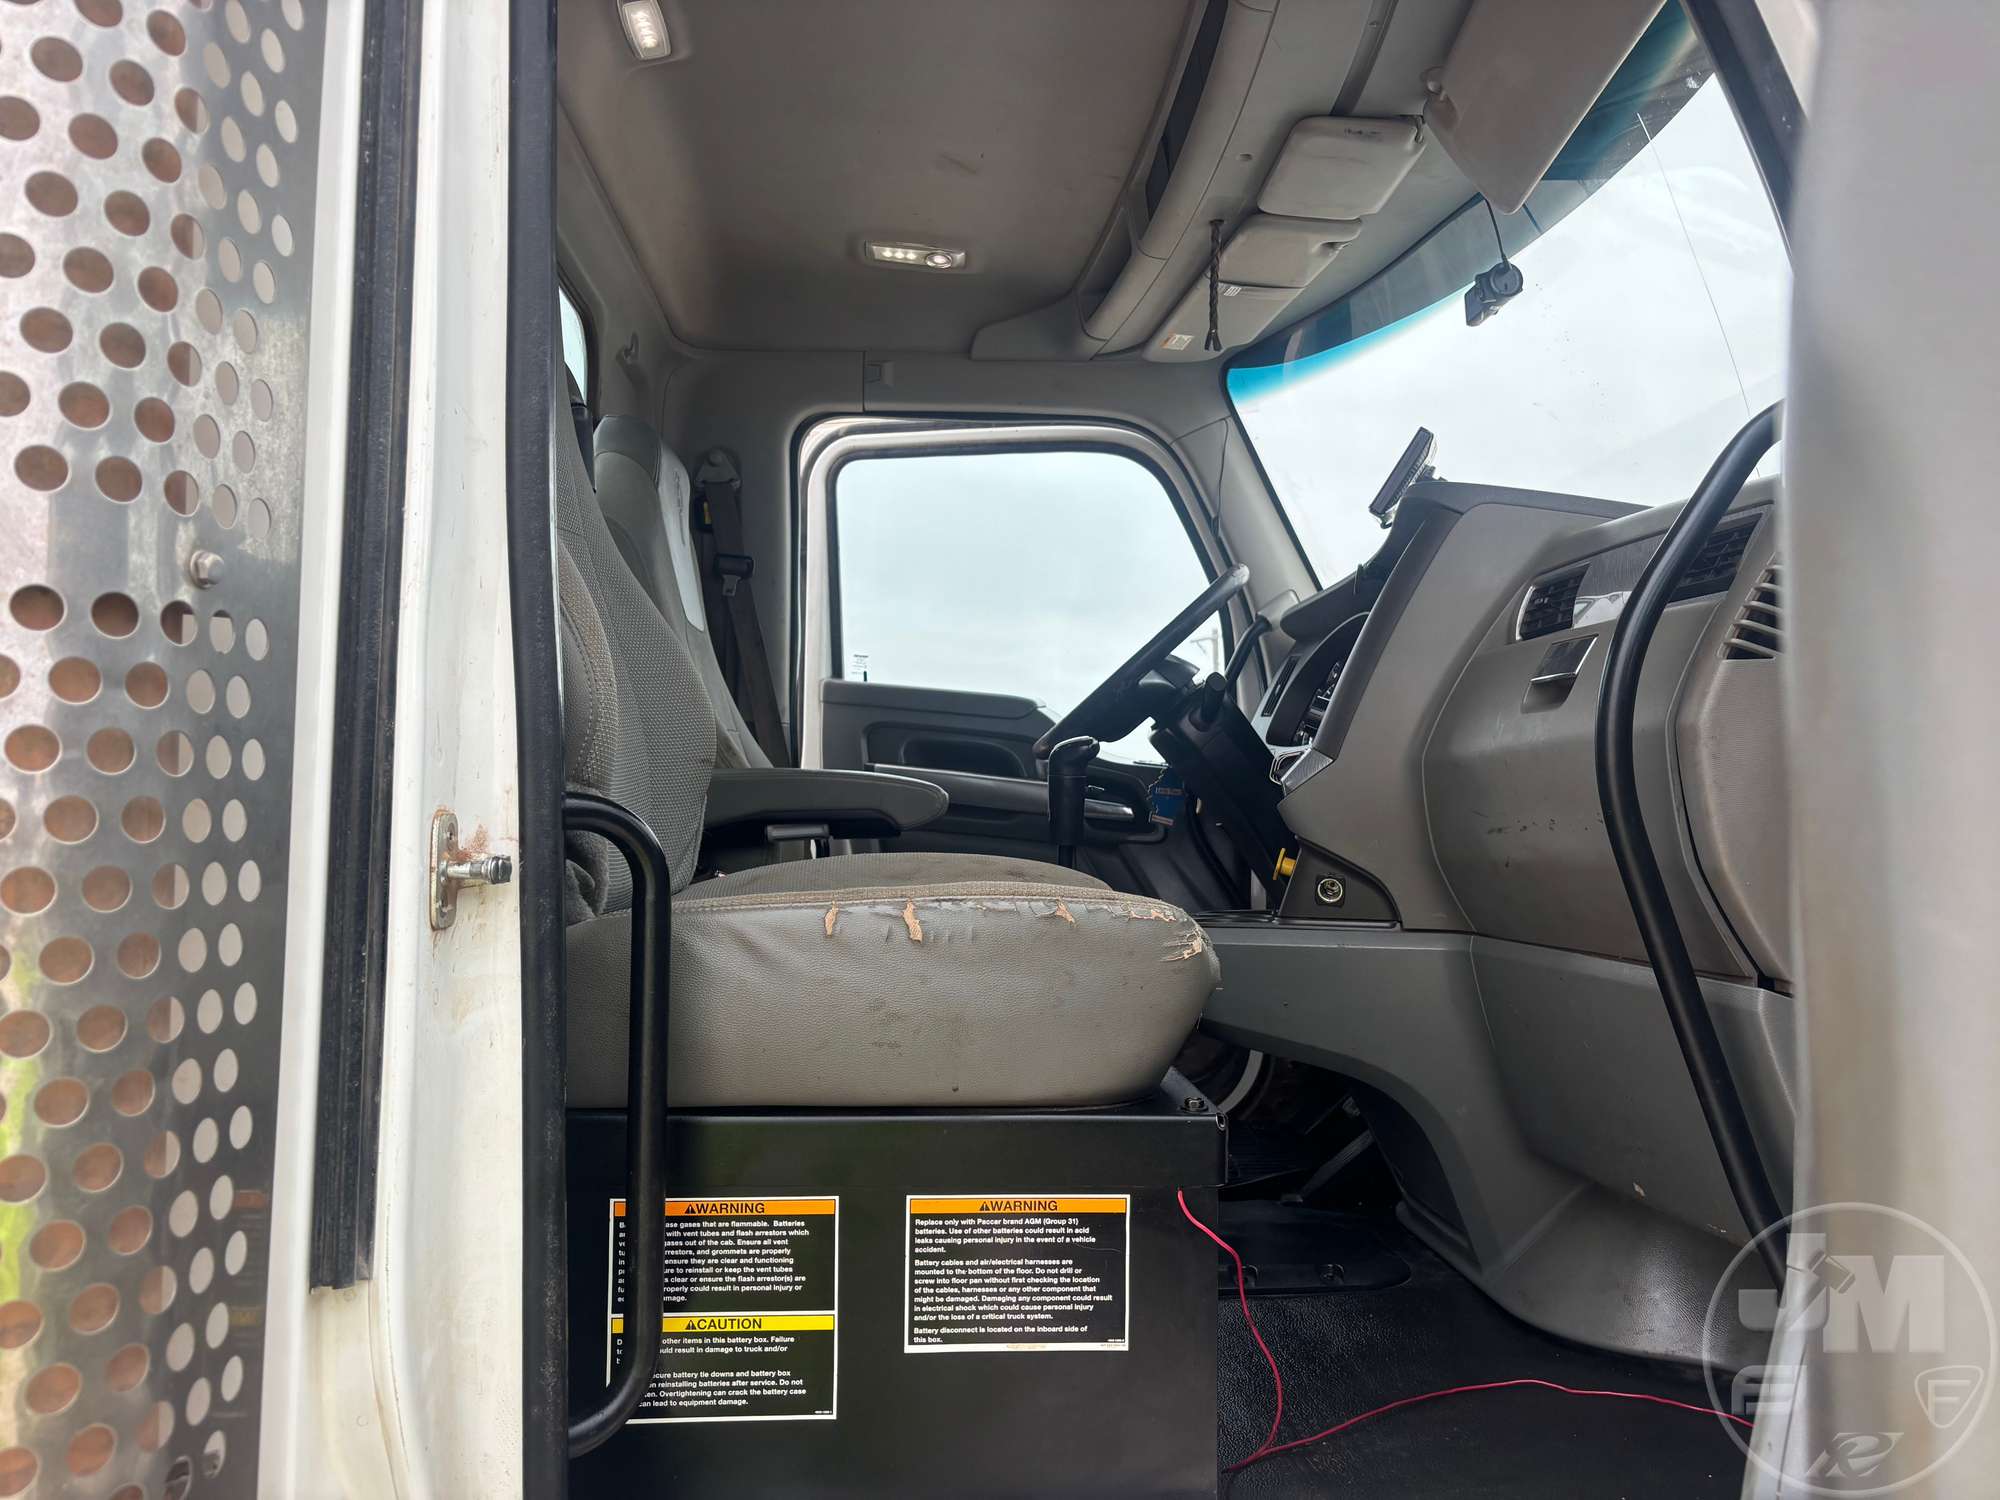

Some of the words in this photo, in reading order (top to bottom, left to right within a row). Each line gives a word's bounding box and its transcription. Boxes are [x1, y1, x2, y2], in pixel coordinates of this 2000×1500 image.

[695, 1204, 765, 1214] WARNING
[991, 1201, 1058, 1211] WARNING
[915, 1219, 943, 1227] Replace
[944, 1219, 959, 1227] only
[1043, 1218, 1067, 1226] (Group
[1068, 1218, 1079, 1226] 31)
[934, 1237, 962, 1245] causing
[963, 1237, 994, 1245] personal
[994, 1237, 1014, 1245] injury
[711, 1248, 747, 1256] grommets
[761, 1248, 791, 1256] properly
[690, 1258, 706, 1266] they
[754, 1257, 794, 1266] functioning
[914, 1259, 940, 1267] Battery
[724, 1267, 742, 1275] keep
[914, 1268, 945, 1276] mounted
[1027, 1277, 1058, 1285] checking
[741, 1285, 772, 1293] personal
[773, 1284, 793, 1293] injury
[1042, 1286, 1081, 1294] component
[914, 1296, 934, 1304] might
[945, 1296, 980, 1304] damaged.
[981, 1295, 1017, 1304] Damaging
[1032, 1295, 1071, 1303] component
[1043, 1304, 1073, 1312] personal
[1074, 1304, 1094, 1312] injury
[1026, 1313, 1054, 1321] system.
[698, 1319, 762, 1330] CAUTION
[914, 1327, 939, 1335] Battery
[727, 1337, 752, 1345] battery
[705, 1346, 733, 1355] damage
[673, 1372, 698, 1380] battery
[751, 1370, 776, 1379] battery
[658, 1381, 697, 1389] reinstalling
[698, 1380, 730, 1388] batteries
[659, 1390, 712, 1398] Overtightening
[762, 1389, 788, 1397] battery
[679, 1399, 717, 1408] equipment
[718, 1399, 749, 1407] damage.
